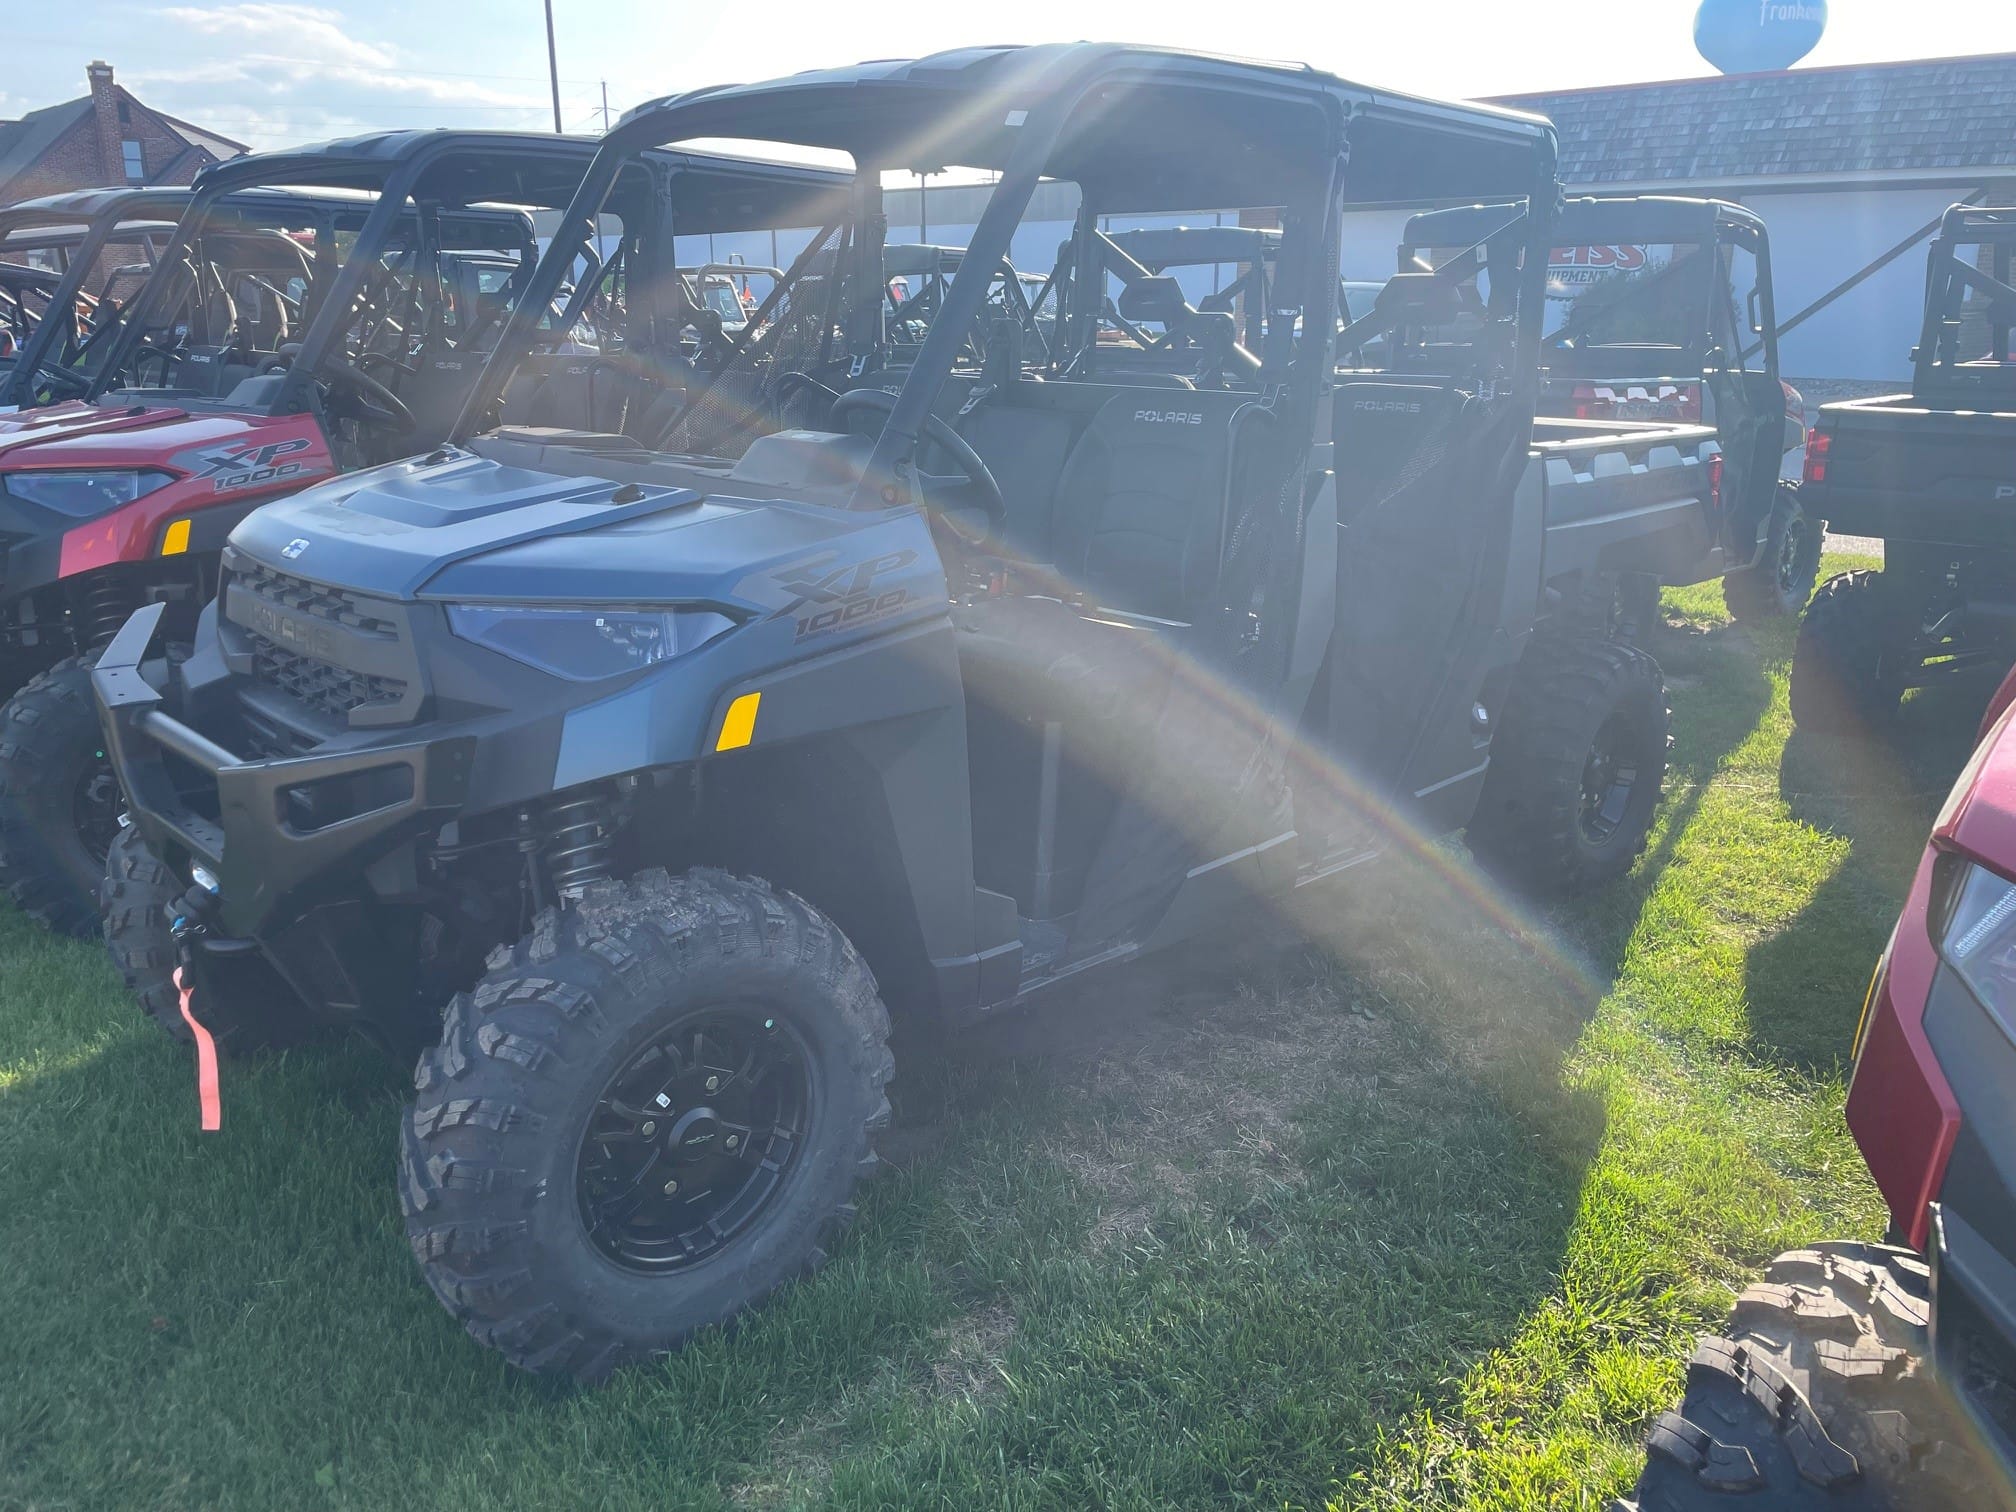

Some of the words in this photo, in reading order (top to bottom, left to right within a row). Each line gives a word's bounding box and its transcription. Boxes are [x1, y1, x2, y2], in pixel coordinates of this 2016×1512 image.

[1547, 245, 1647, 271] EISS
[1548, 270, 1609, 283] UIPMENT
[1134, 410, 1203, 425] POLARIS
[1353, 400, 1422, 413] POLARIS
[186, 438, 313, 483] XP
[213, 462, 303, 492] 1000
[764, 549, 921, 623] XP
[796, 588, 907, 636] 1000
